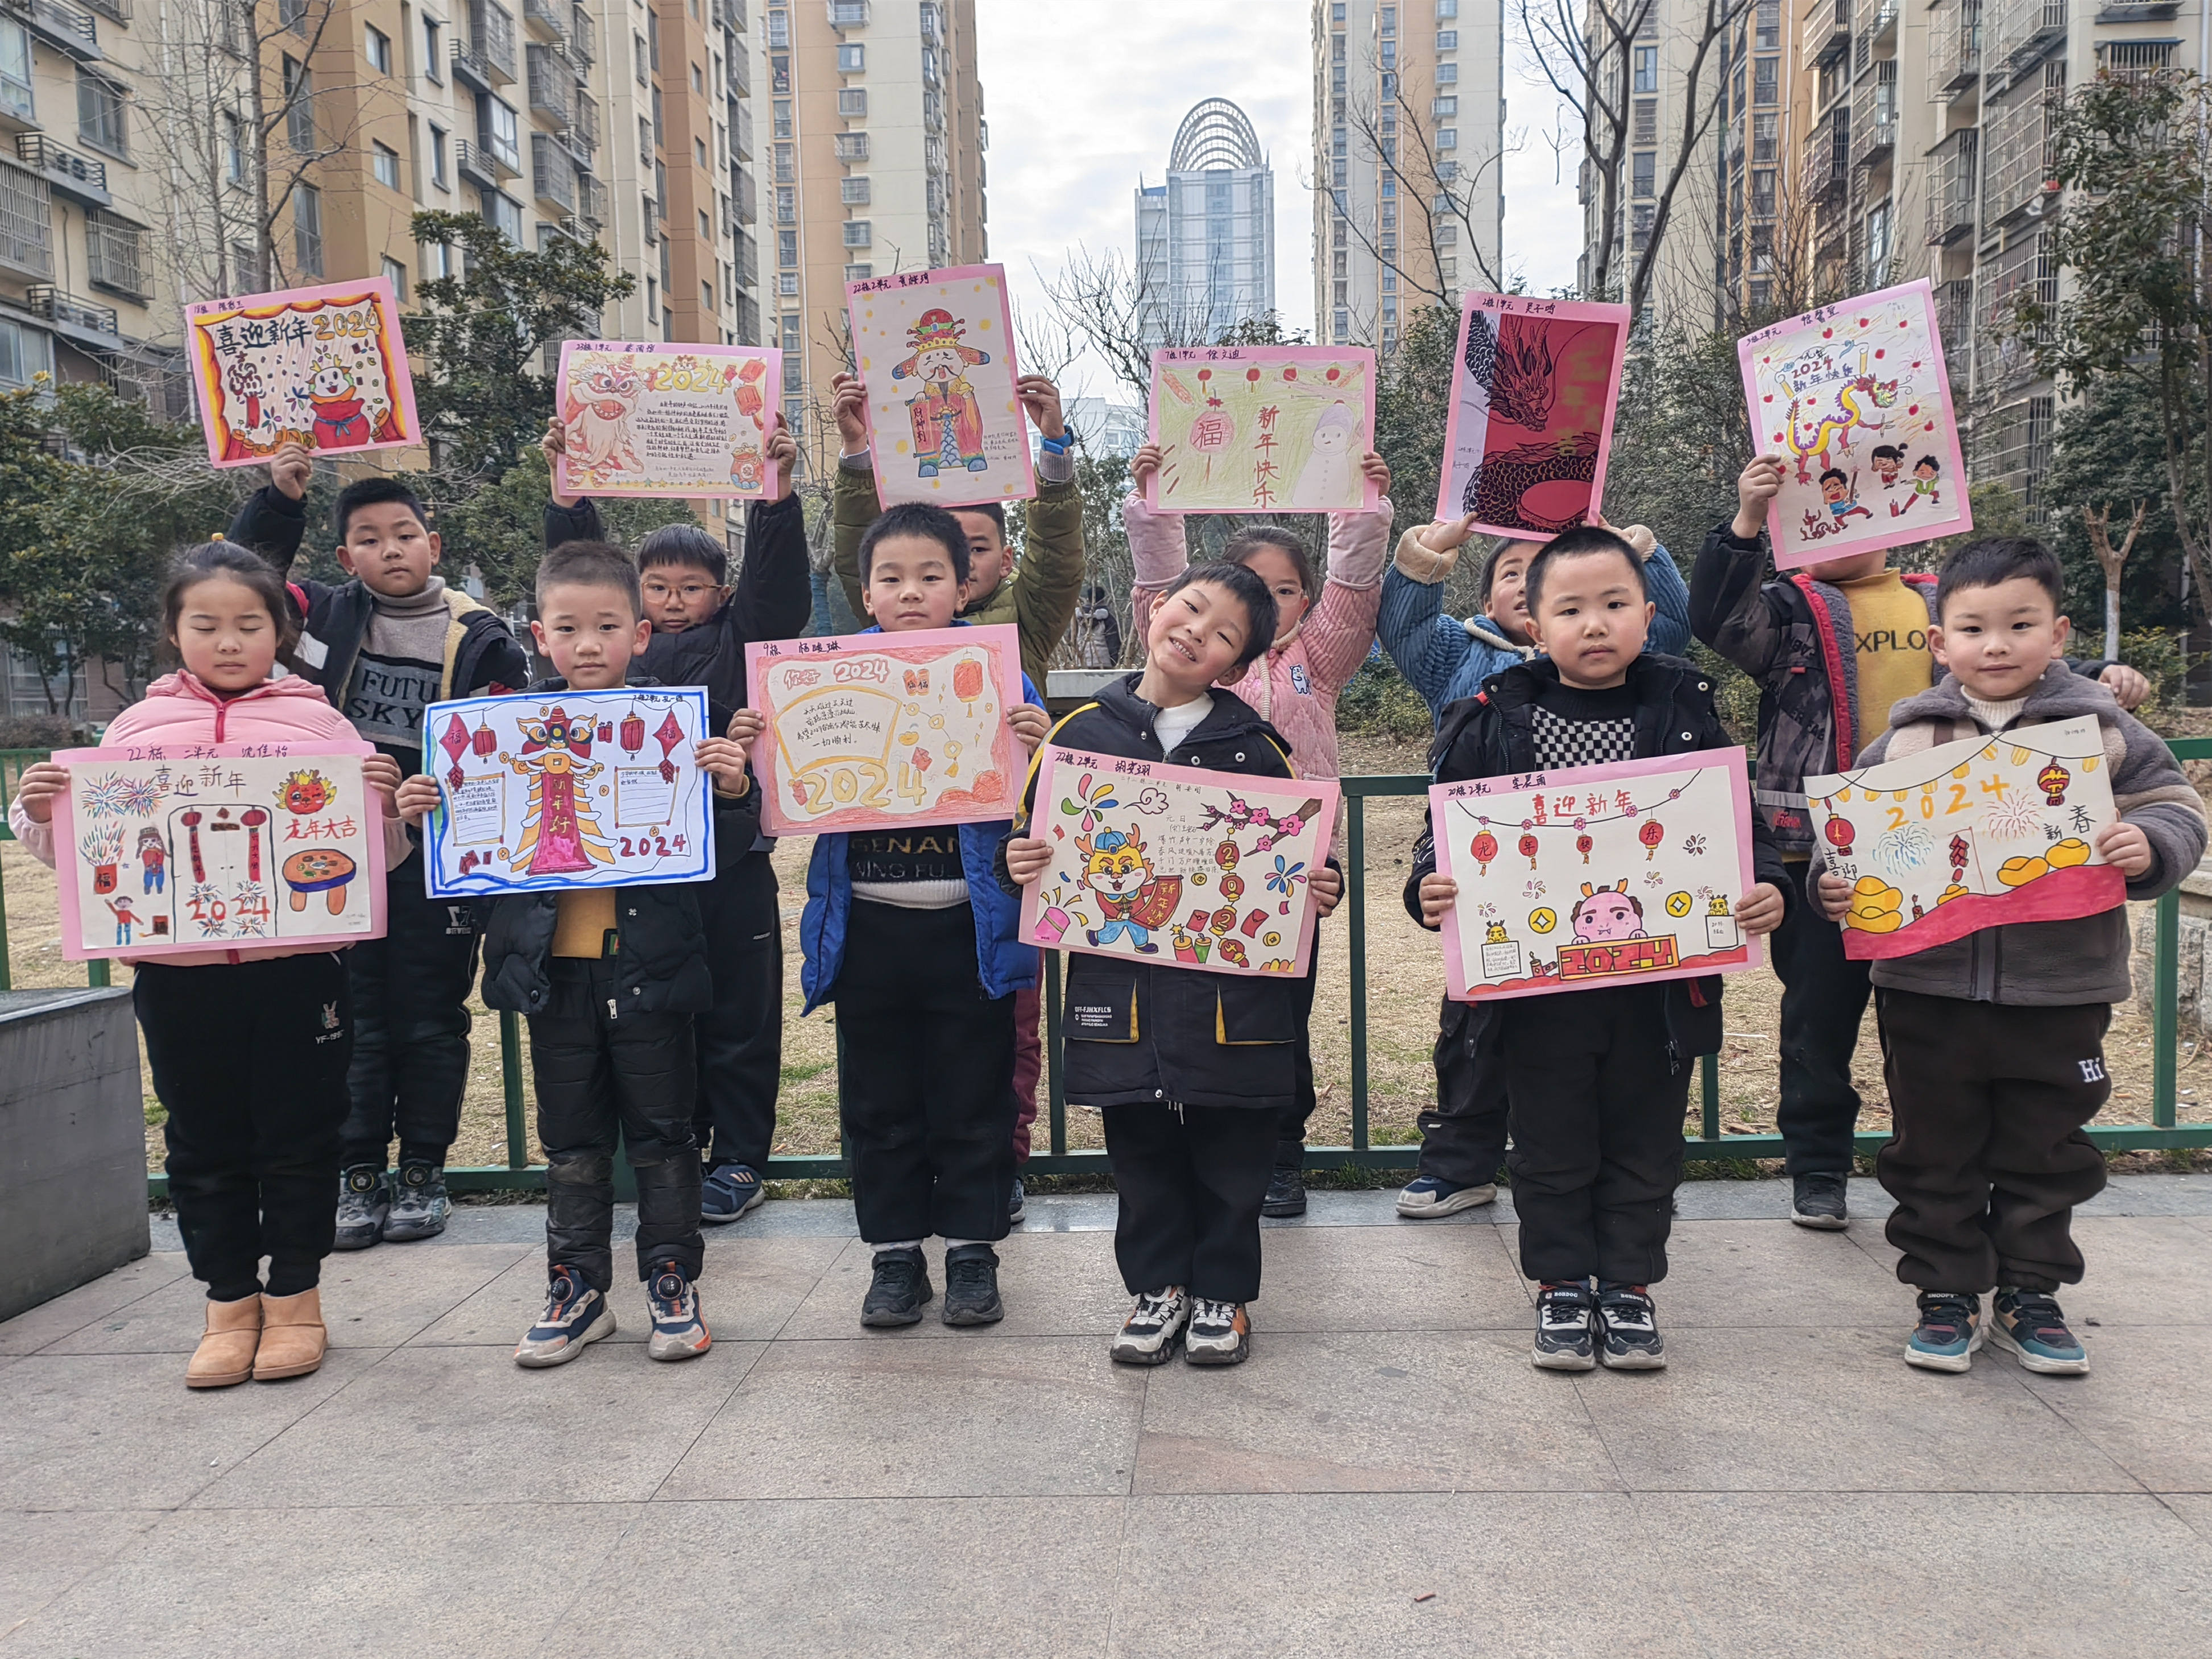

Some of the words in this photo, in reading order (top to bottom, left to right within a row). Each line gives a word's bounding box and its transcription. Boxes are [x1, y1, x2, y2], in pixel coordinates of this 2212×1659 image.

[216, 316, 312, 356] 喜迎新年
[312, 309, 382, 340] 2024
[653, 366, 728, 395] 2024
[1791, 355, 1833, 379] 2024
[914, 407, 926, 442] 财神到
[1193, 419, 1224, 448] 福
[1253, 405, 1280, 509] 新年快乐
[784, 669, 821, 690] 你好
[834, 658, 890, 684] 2024
[348, 698, 425, 730] SKY
[449, 730, 461, 744] 福
[662, 727, 676, 739] 福
[155, 764, 246, 798] 喜迎新年
[801, 762, 927, 815] 2024
[549, 777, 571, 834] 新年好
[1532, 790, 1633, 826] 喜迎新年
[1886, 775, 2010, 830] 2024
[283, 815, 358, 842] 龙年大吉
[620, 834, 687, 857] 2024
[97, 872, 111, 887] 福
[186, 897, 270, 923] 2024
[1145, 882, 1176, 925] 新年快乐
[1561, 940, 1672, 977] 2024
